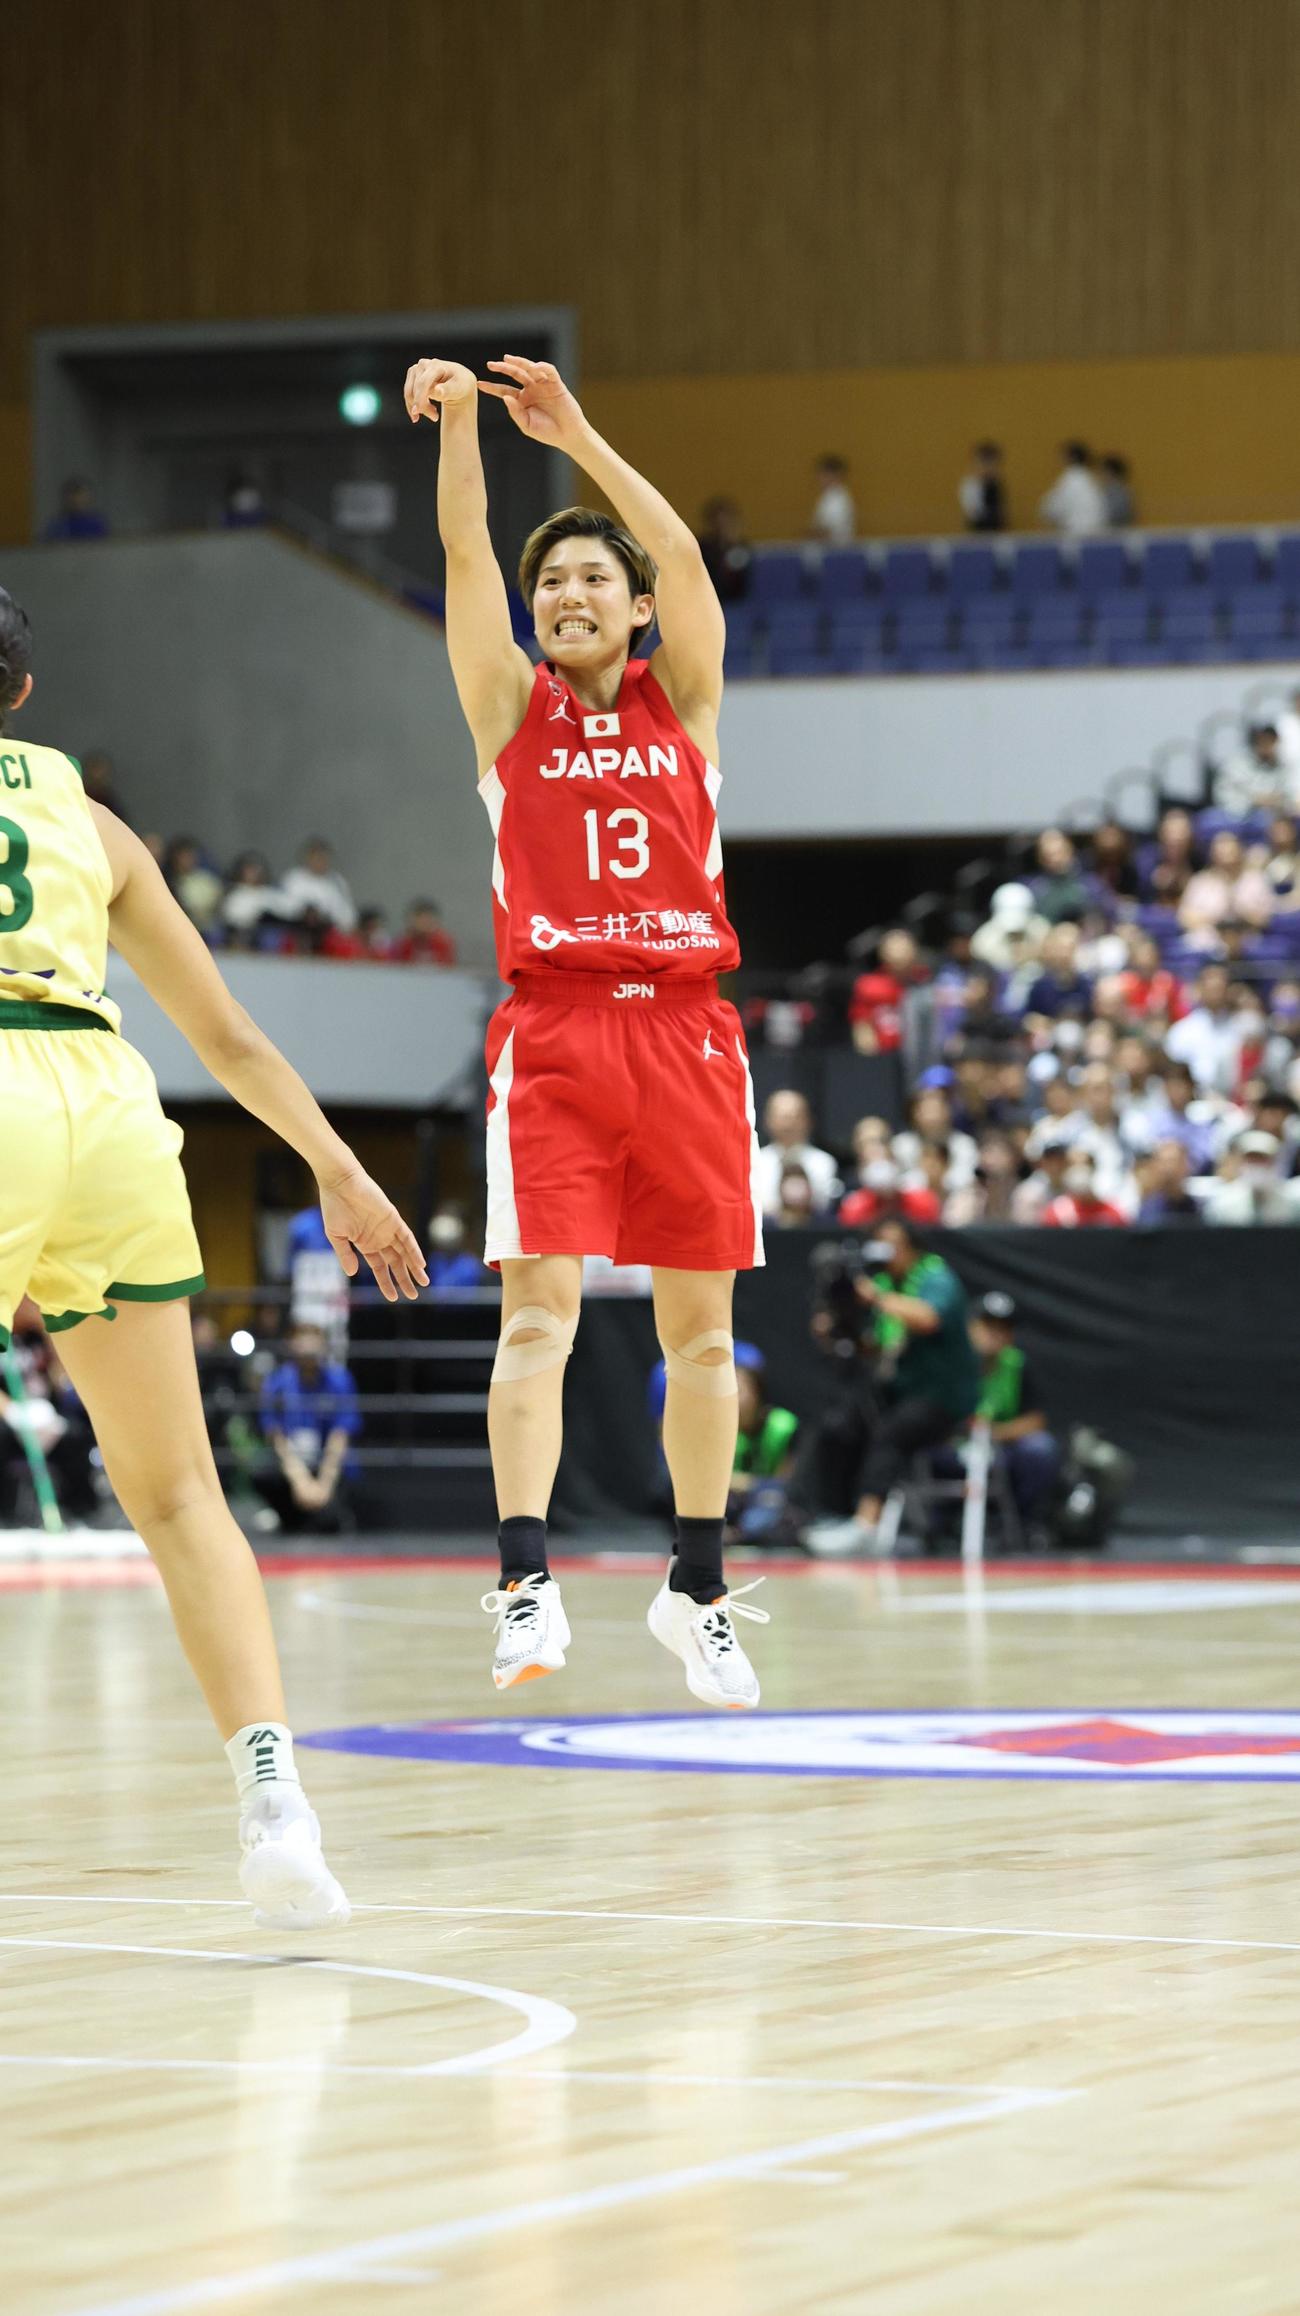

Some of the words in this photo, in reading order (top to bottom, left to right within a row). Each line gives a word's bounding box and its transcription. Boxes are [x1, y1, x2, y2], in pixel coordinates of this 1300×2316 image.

[0, 754, 32, 789] CI
[539, 744, 679, 780] JAPAN
[583, 807, 651, 881] 13
[574, 909, 716, 940] 三井不動産
[612, 983, 655, 999] JPN
